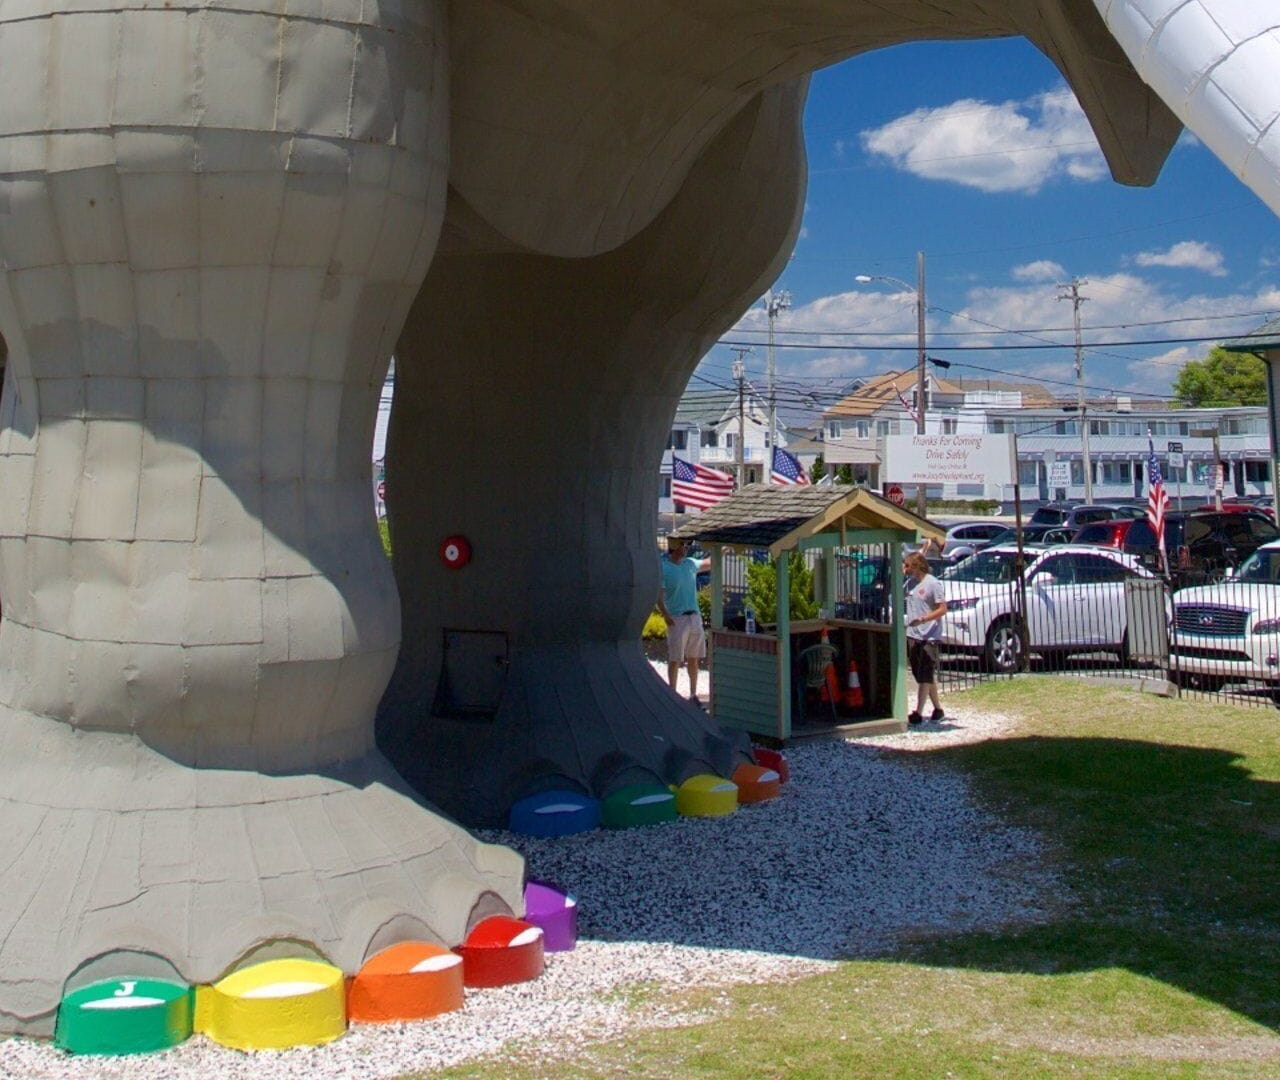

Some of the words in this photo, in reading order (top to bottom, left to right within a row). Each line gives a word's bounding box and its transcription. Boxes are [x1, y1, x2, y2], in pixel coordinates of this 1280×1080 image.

[913, 436, 937, 446] Thanks
[939, 436, 950, 446] For
[953, 436, 982, 449] Coming
[926, 449, 944, 459] Drive
[946, 449, 969, 462] Safely
